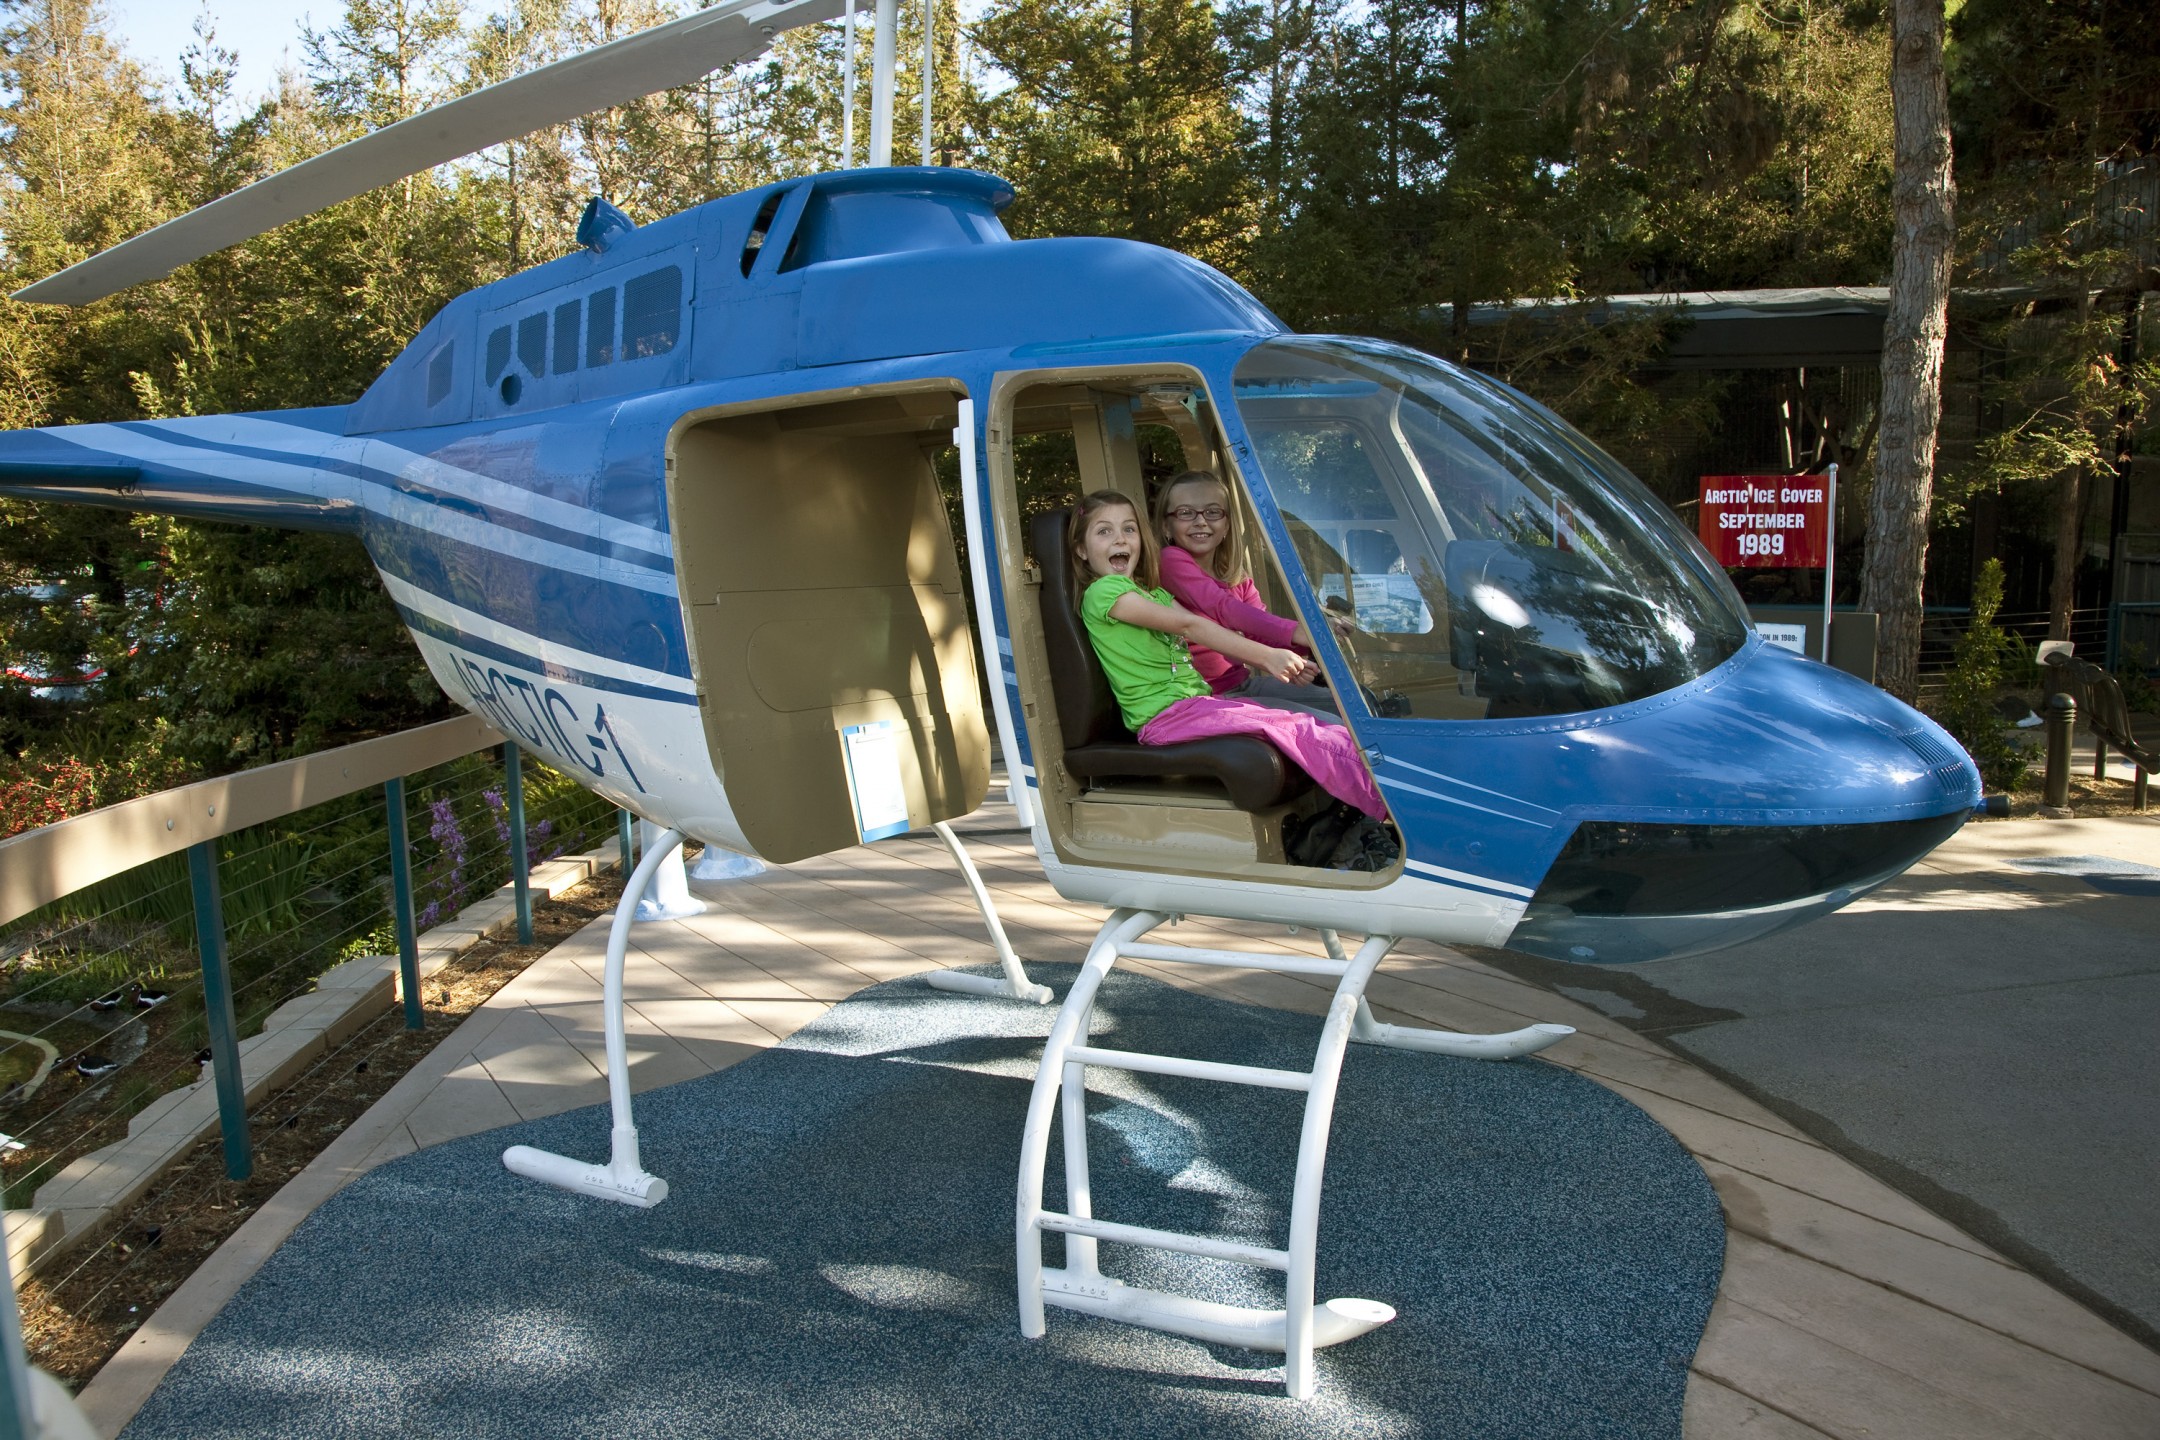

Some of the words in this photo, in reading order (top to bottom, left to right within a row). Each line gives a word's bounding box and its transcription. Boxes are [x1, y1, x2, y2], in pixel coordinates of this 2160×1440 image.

[1704, 488, 1749, 504] ARCTIC
[1753, 488, 1776, 504] ICE
[1780, 488, 1823, 503] COVER
[1718, 512, 1805, 529] SEPTEMBER
[1736, 533, 1784, 555] 1989
[1772, 633, 1779, 641] IN
[1780, 634, 1798, 642] 1989:
[449, 652, 646, 794] ARCTIC-1
